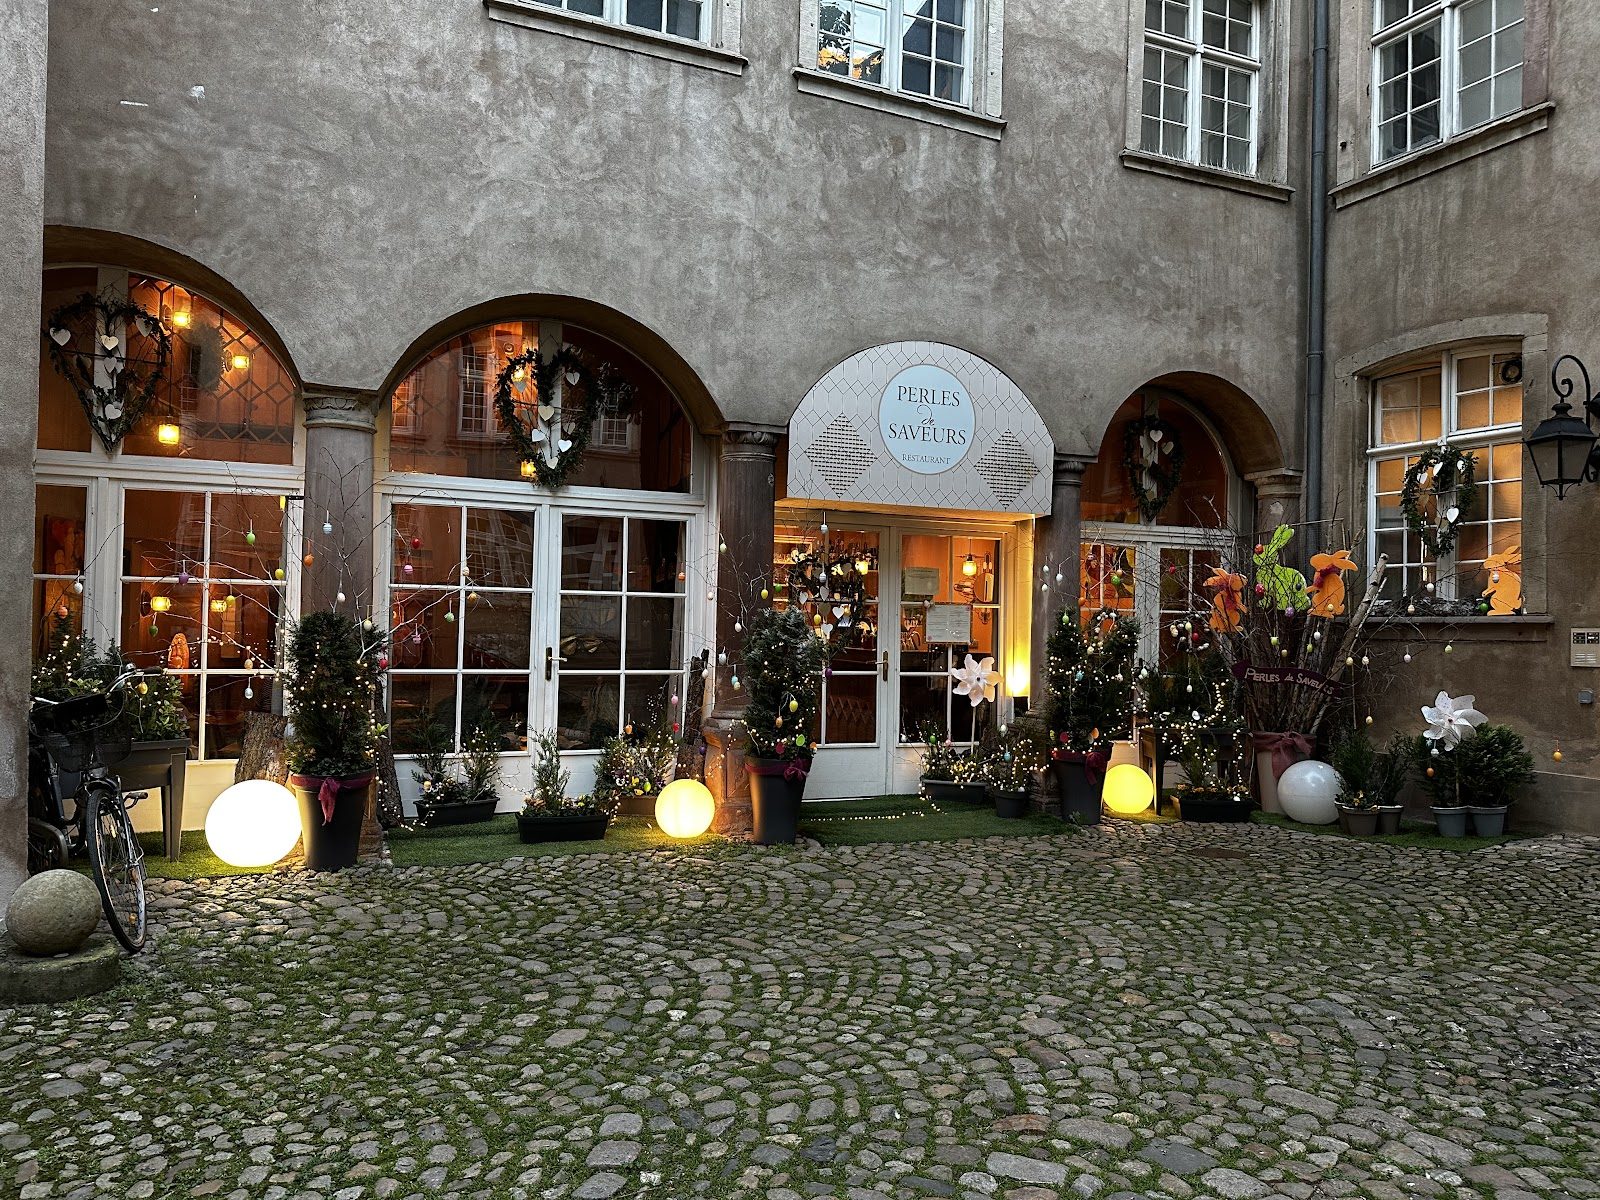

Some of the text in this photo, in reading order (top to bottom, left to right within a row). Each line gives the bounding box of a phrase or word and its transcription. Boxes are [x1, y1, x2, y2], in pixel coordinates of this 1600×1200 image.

[897, 385, 960, 407] PERLES
[916, 404, 935, 426] de
[888, 422, 966, 445] SAVEURS
[902, 453, 951, 465] RESTAURANT
[1244, 667, 1280, 683] PERLES
